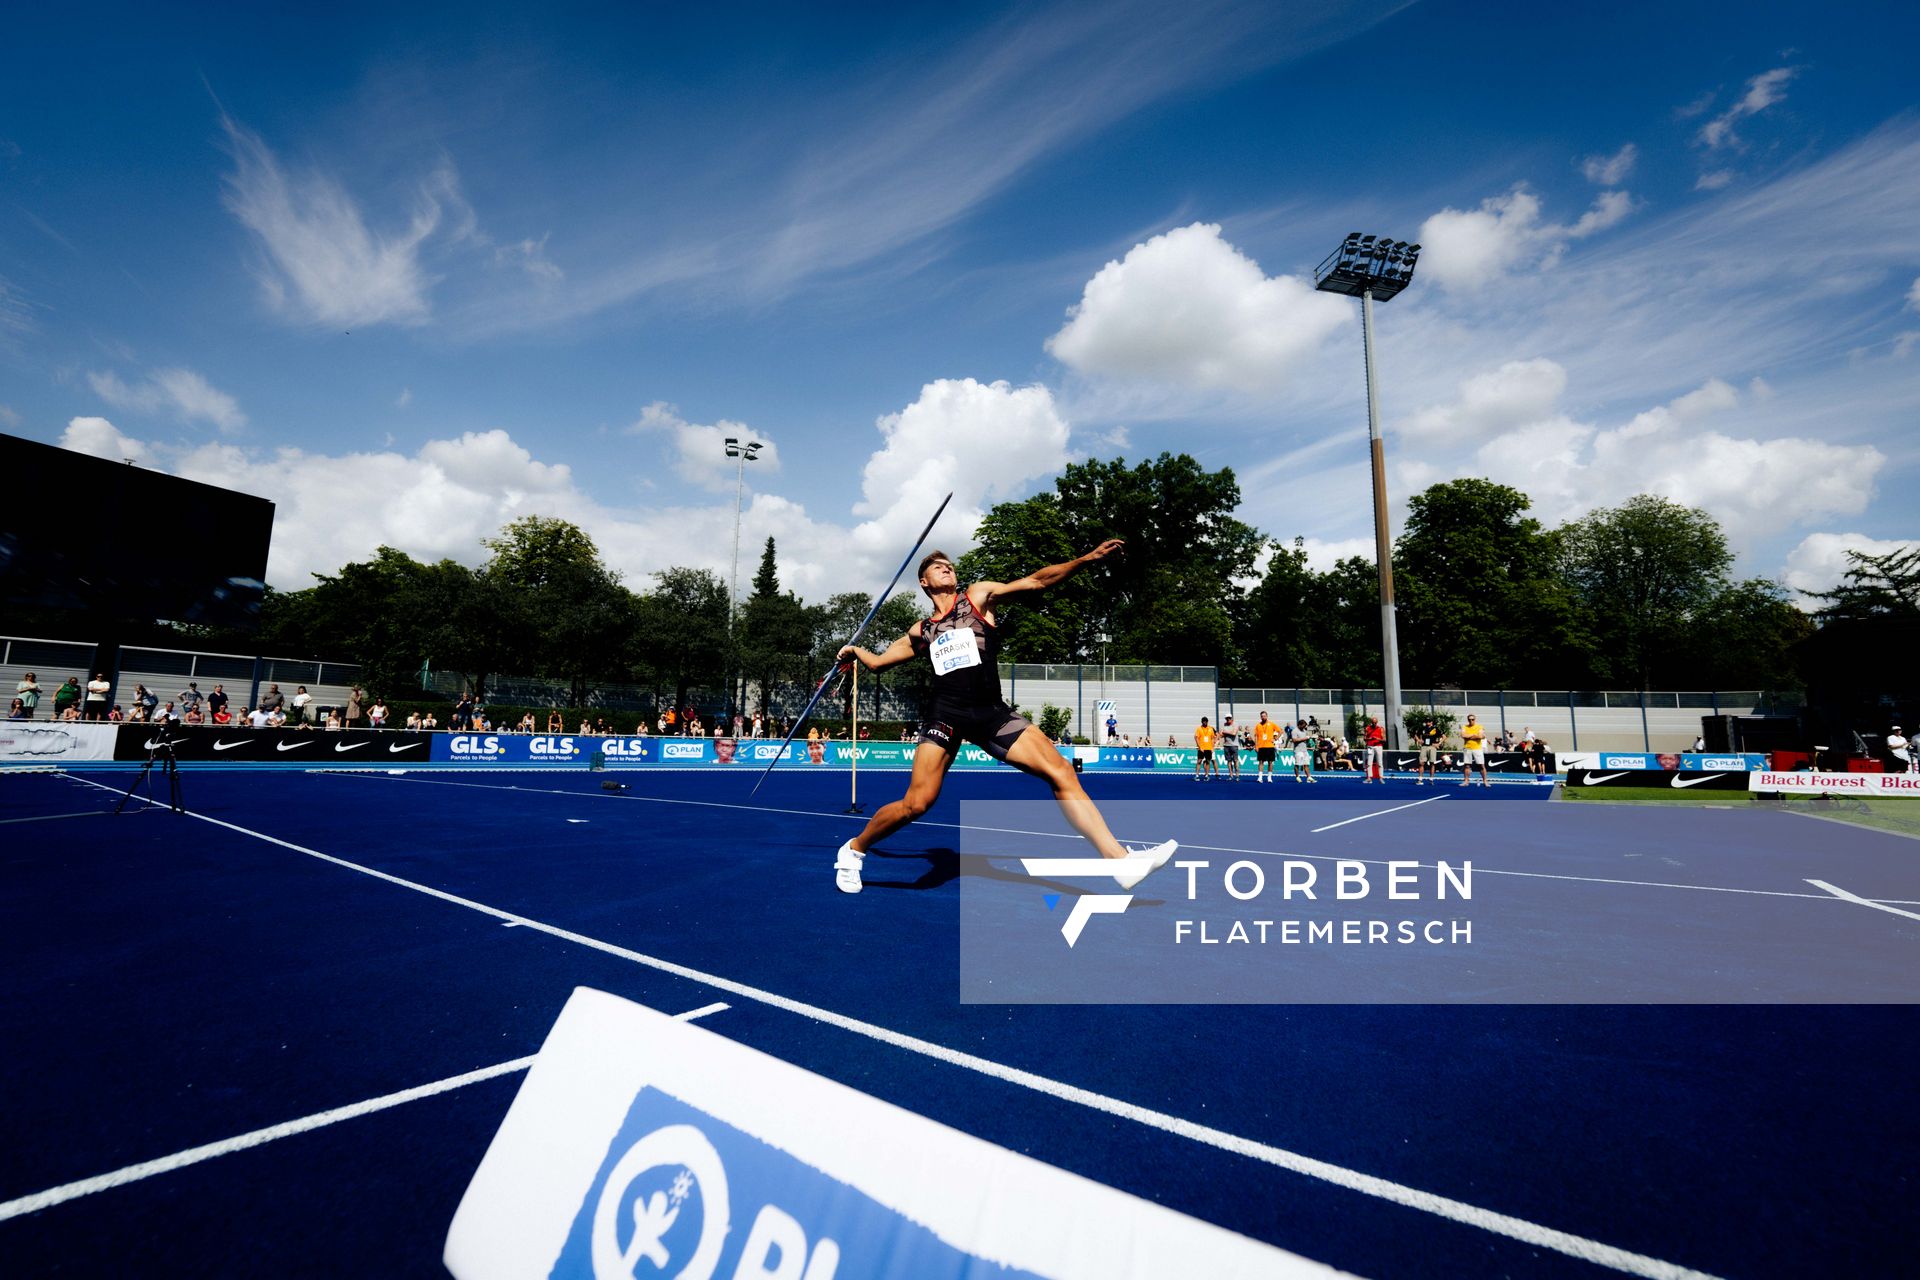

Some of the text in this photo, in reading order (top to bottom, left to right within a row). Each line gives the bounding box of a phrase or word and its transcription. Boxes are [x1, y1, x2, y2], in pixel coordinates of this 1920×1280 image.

[1155, 753, 1185, 764] WGV
[1217, 754, 1248, 765] WV
[1760, 774, 1866, 787] Black Forest
